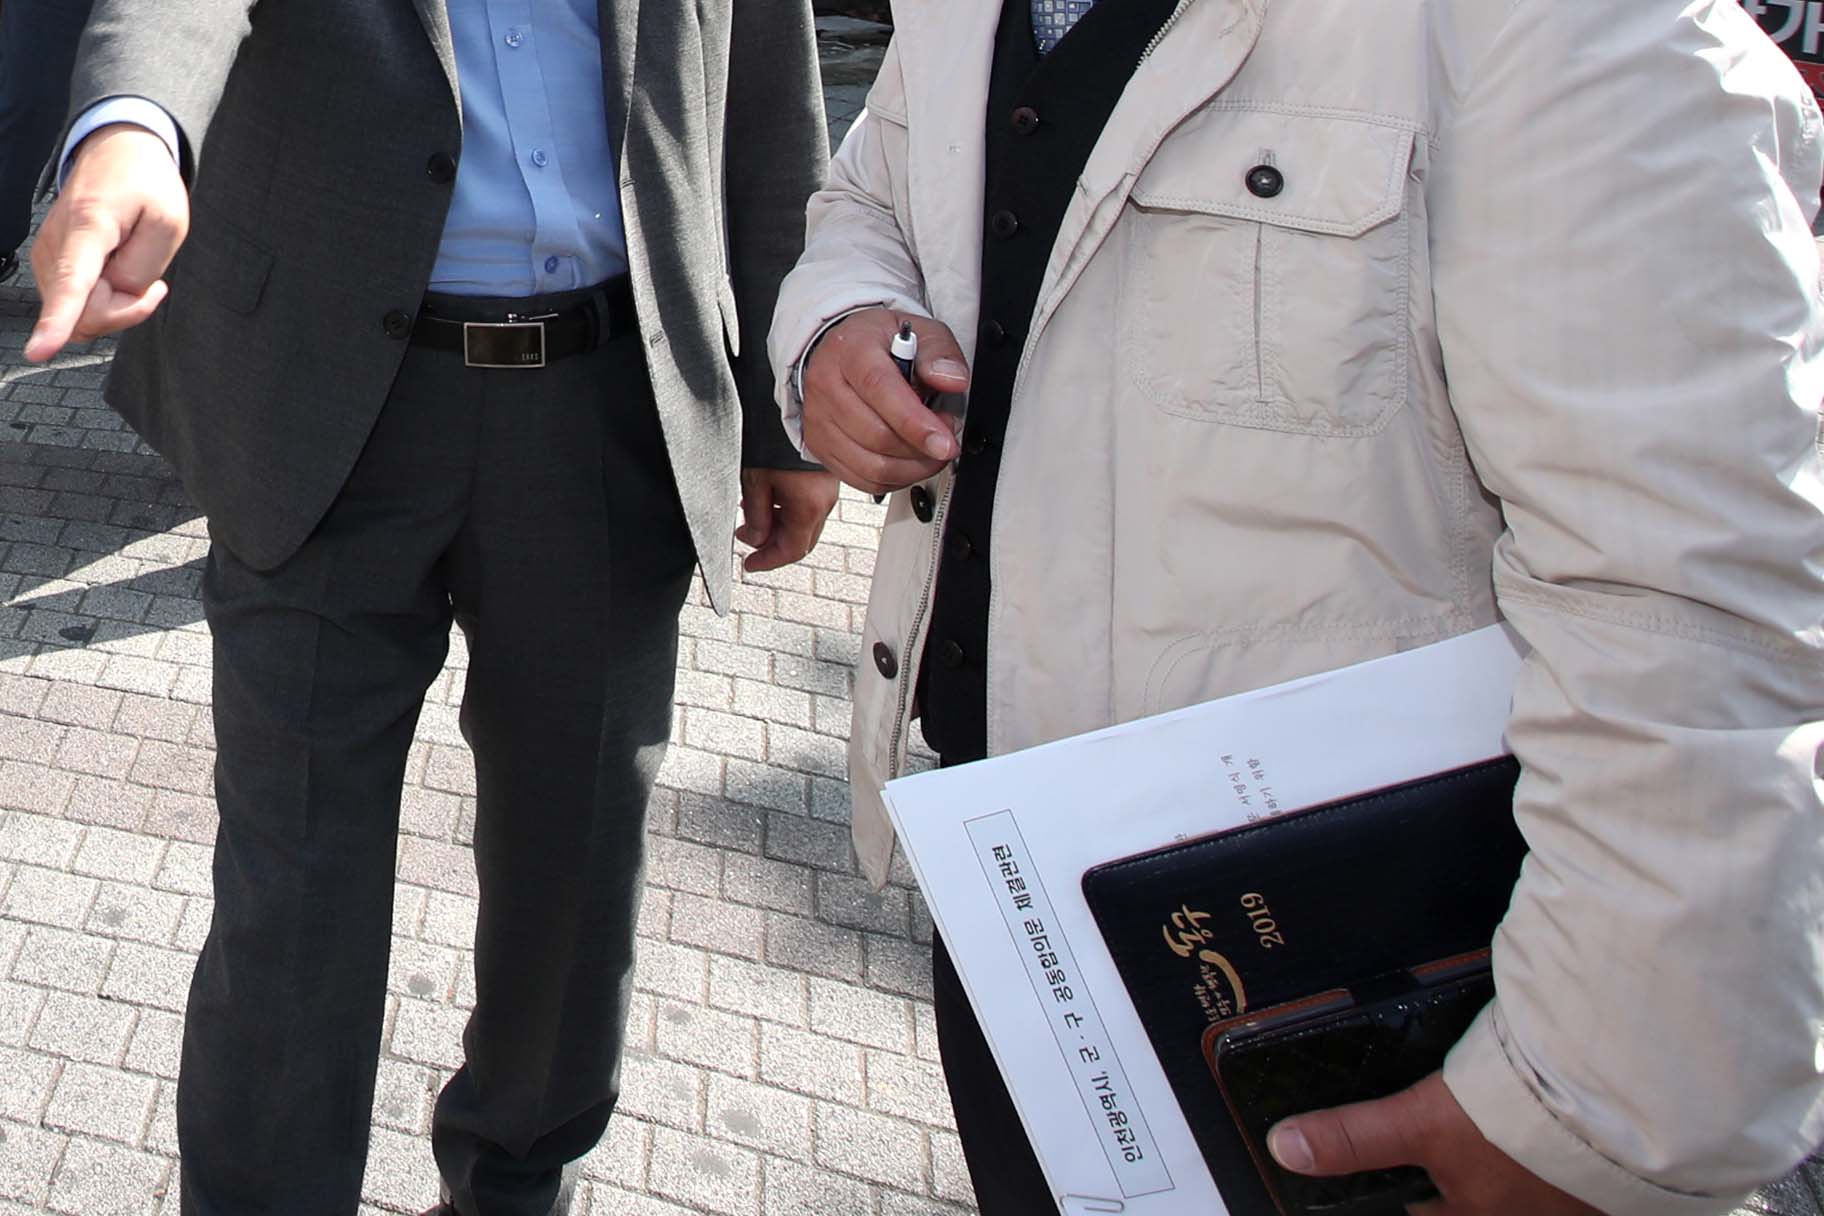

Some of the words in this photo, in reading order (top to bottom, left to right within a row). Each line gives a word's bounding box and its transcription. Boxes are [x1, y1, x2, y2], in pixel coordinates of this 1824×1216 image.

[992, 844, 1034, 911] 체결관련
[1240, 892, 1285, 949] 2019
[1024, 918, 1074, 1003] 공동합의문
[1064, 1012, 1083, 1029] 구
[1079, 1046, 1101, 1063] 군
[1091, 1071, 1143, 1163] 인천광역시,
